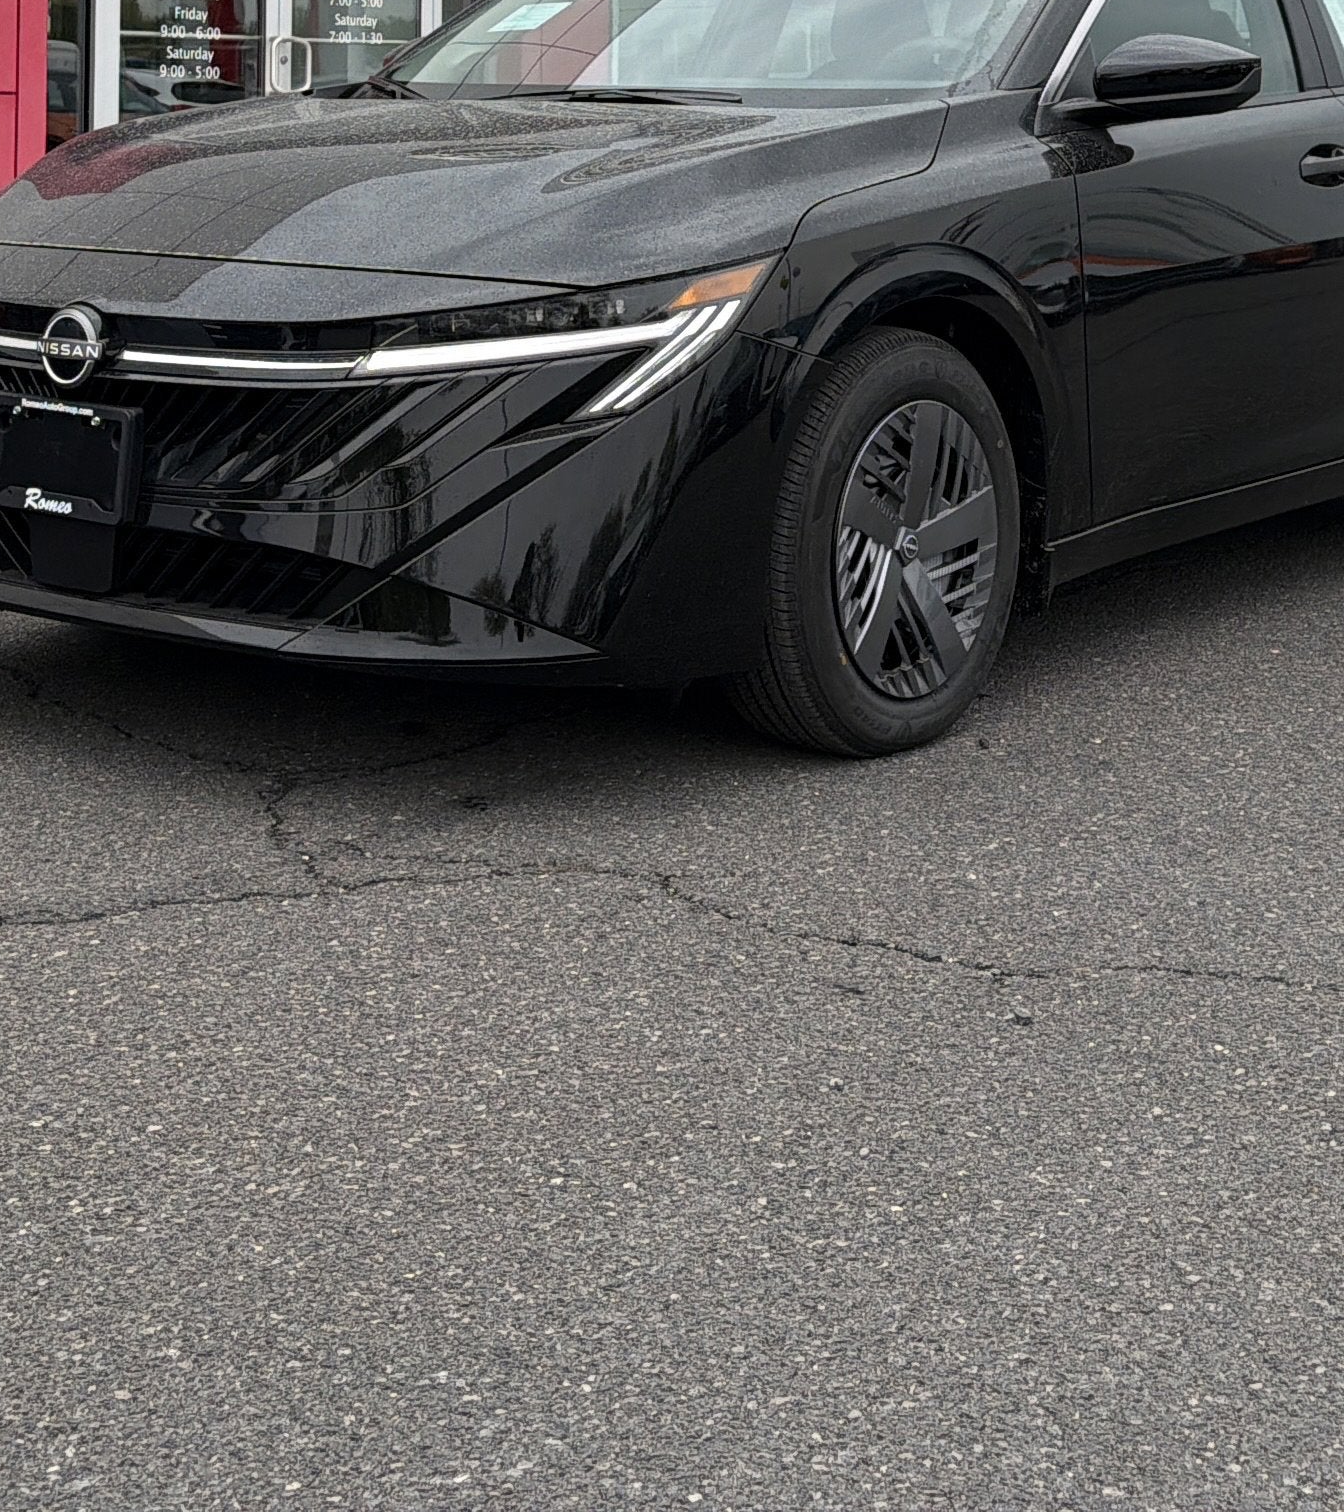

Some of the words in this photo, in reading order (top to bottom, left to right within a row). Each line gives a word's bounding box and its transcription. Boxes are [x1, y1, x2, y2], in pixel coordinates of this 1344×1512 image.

[174, 6, 209, 23] Friday
[334, 13, 378, 29] Saturday
[160, 24, 186, 39] 9:00
[196, 26, 222, 40] 6:00
[328, 31, 352, 44] 7:00
[361, 32, 383, 45] 1:30
[166, 45, 215, 63] Saturday
[159, 64, 186, 78] 9:00
[195, 65, 221, 80] 5:00
[37, 340, 99, 358] NISSAN
[23, 487, 73, 515] Romeo
